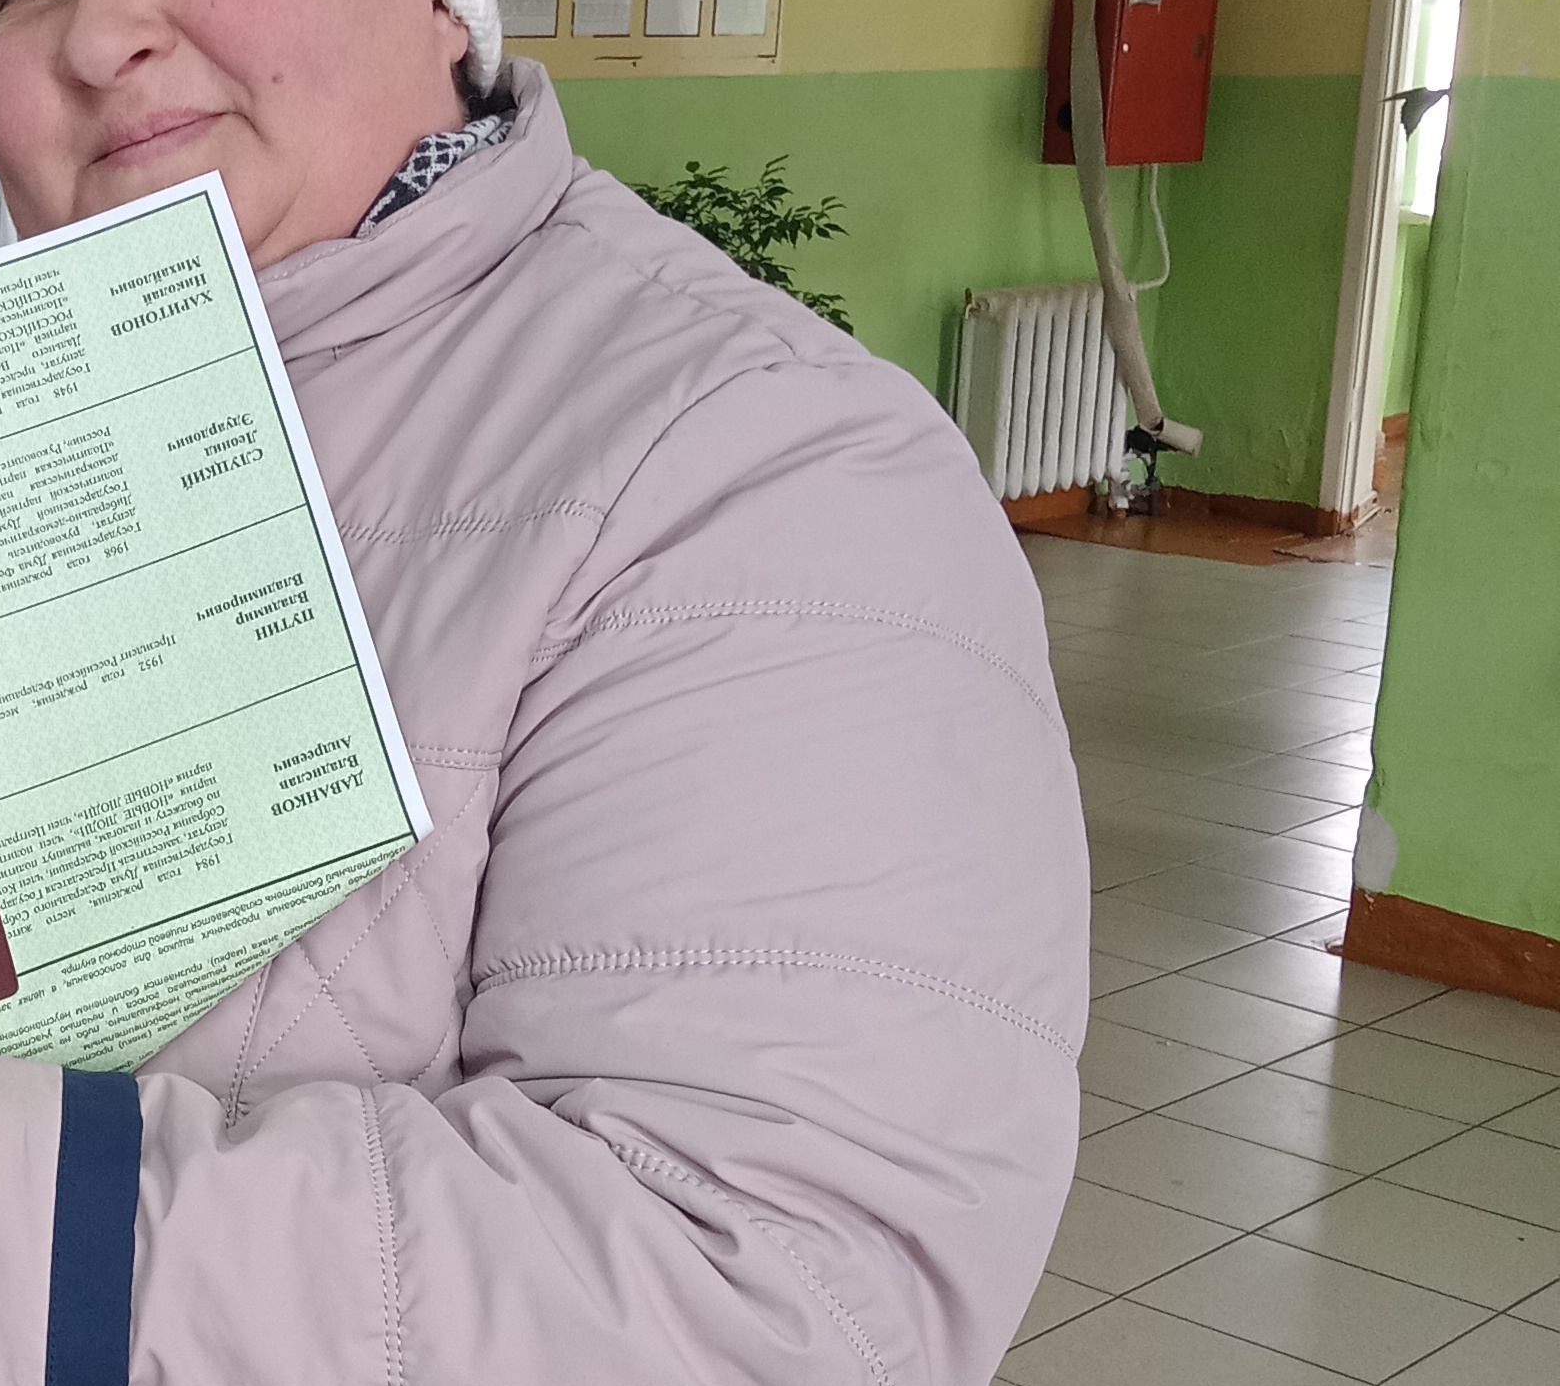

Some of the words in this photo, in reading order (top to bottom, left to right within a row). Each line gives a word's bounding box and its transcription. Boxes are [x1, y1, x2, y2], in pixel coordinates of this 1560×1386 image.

[109, 254, 202, 297] Михайлович
[141, 272, 208, 307] Николай
[110, 289, 214, 337] ХАРИТОНОВ
[31, 333, 82, 359] Дальнего
[33, 321, 78, 345] партией
[40, 347, 86, 371] депутат,
[0, 362, 92, 400] Государственная
[52, 381, 79, 399] 1948
[15, 394, 41, 409] года
[166, 412, 254, 453] Эдуардович
[203, 428, 258, 458] Леонид
[48, 465, 124, 502] политической
[179, 447, 264, 492] СЛУЦКИЙ
[36, 480, 130, 522] Государственной
[91, 506, 136, 530] депутат,
[7, 525, 81, 559] руководитель
[50, 520, 142, 561] Государственная
[103, 539, 130, 559] 1968
[17, 552, 48, 572] Дума
[65, 554, 91, 570] года
[195, 572, 305, 622] Владимирович
[235, 589, 310, 626] Владимир
[253, 607, 316, 642] ПУТИН
[119, 634, 177, 663] Президент
[137, 652, 164, 672] 1952
[55, 655, 119, 688] Российской
[97, 667, 126, 684] года
[31, 678, 89, 709] рождения;
[272, 734, 352, 774] Андреевич
[175, 761, 213, 783] партия
[179, 775, 218, 799] партия
[278, 753, 360, 793] Владислав
[205, 789, 221, 806] по
[270, 769, 364, 817] ДАВАНКОВ
[46, 816, 73, 832] член
[155, 793, 205, 825] бюджету
[171, 803, 226, 831] Собрания
[38, 831, 66, 850] член
[92, 815, 142, 845] налогам;
[108, 823, 172, 858] Российской
[182, 816, 229, 846] депутат,
[41, 834, 93, 866] выдвинут
[44, 846, 108, 879] Федерации,
[117, 834, 183, 868] заместитель
[141, 831, 234, 873] Государственная
[194, 851, 221, 872] 1984
[17, 868, 45, 891] член
[44, 856, 118, 898] Председателя
[106, 863, 142, 890] Дума
[156, 866, 182, 883] года
[32, 878, 107, 915] Федерального
[88, 878, 145, 909] рождения;
[45, 903, 77, 926] место
